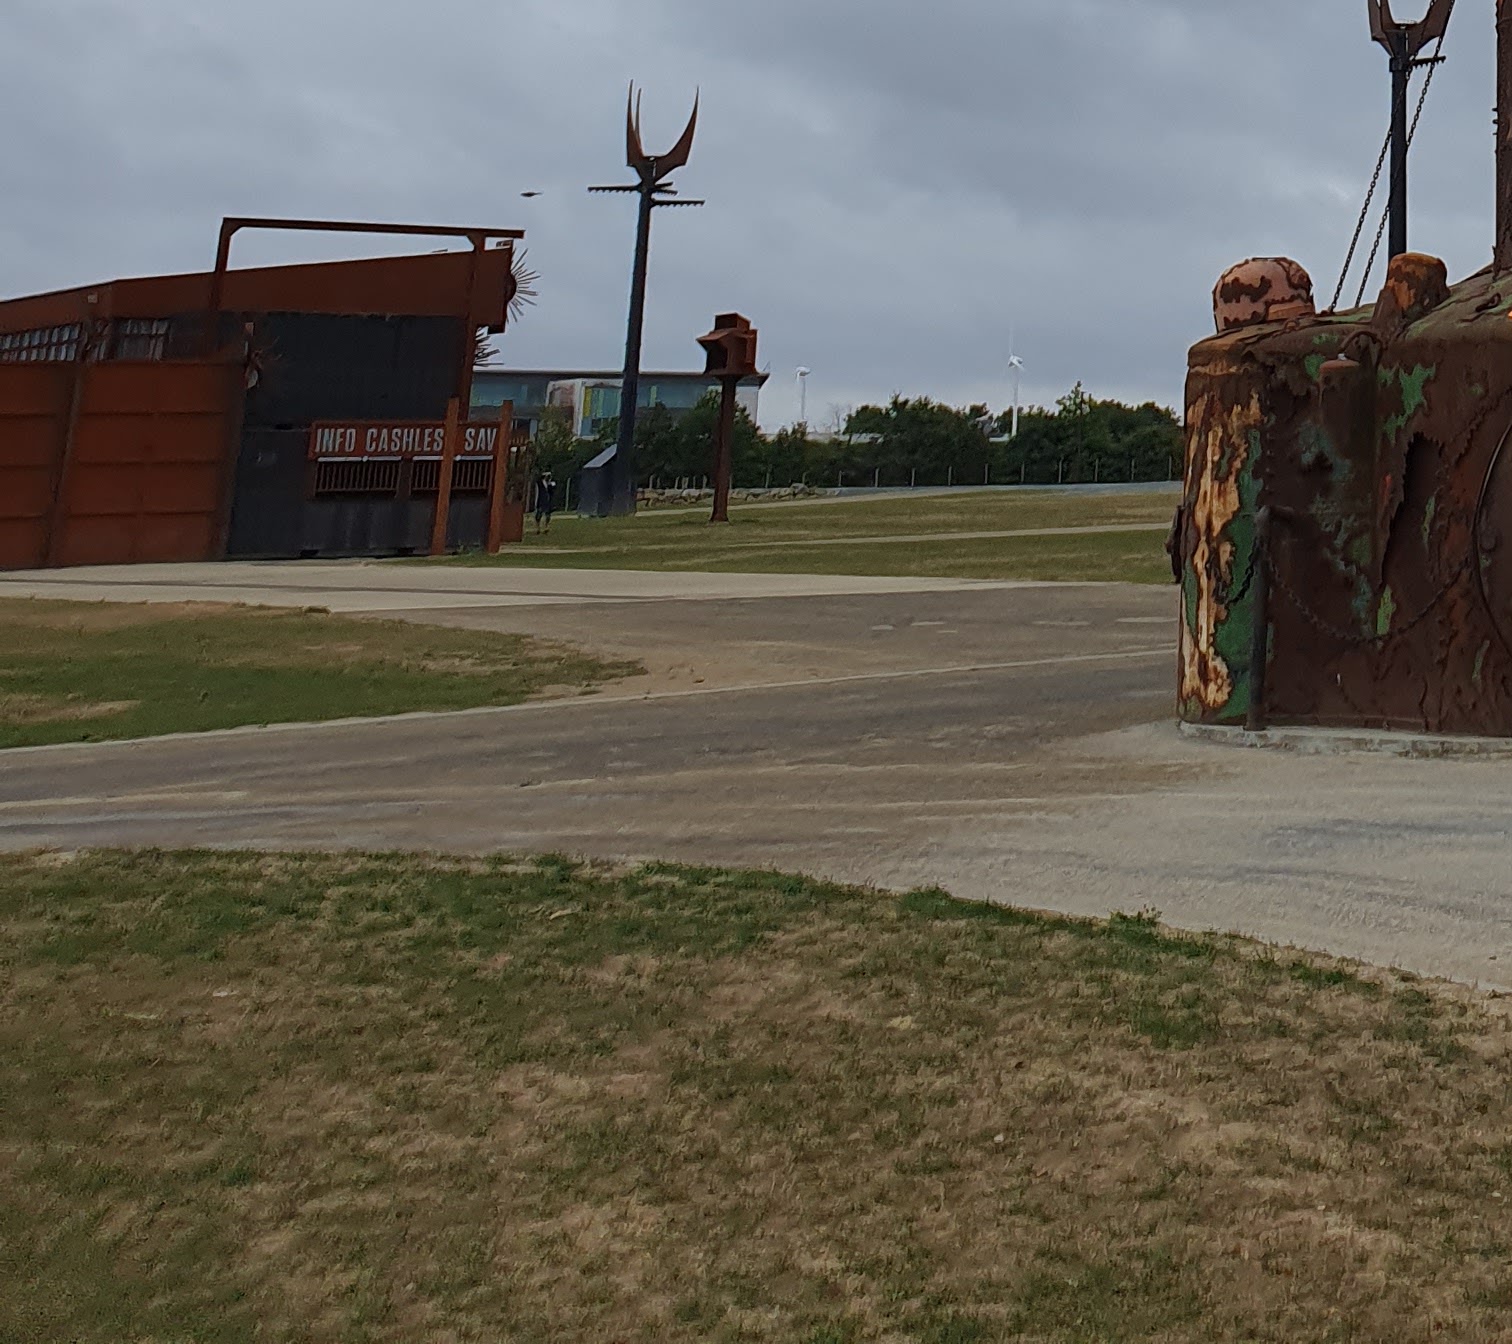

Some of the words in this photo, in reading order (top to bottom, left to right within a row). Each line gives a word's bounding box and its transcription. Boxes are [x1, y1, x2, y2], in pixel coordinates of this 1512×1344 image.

[314, 428, 357, 453] INFO
[365, 427, 446, 452] CASHLES
[464, 427, 498, 452] SAV
